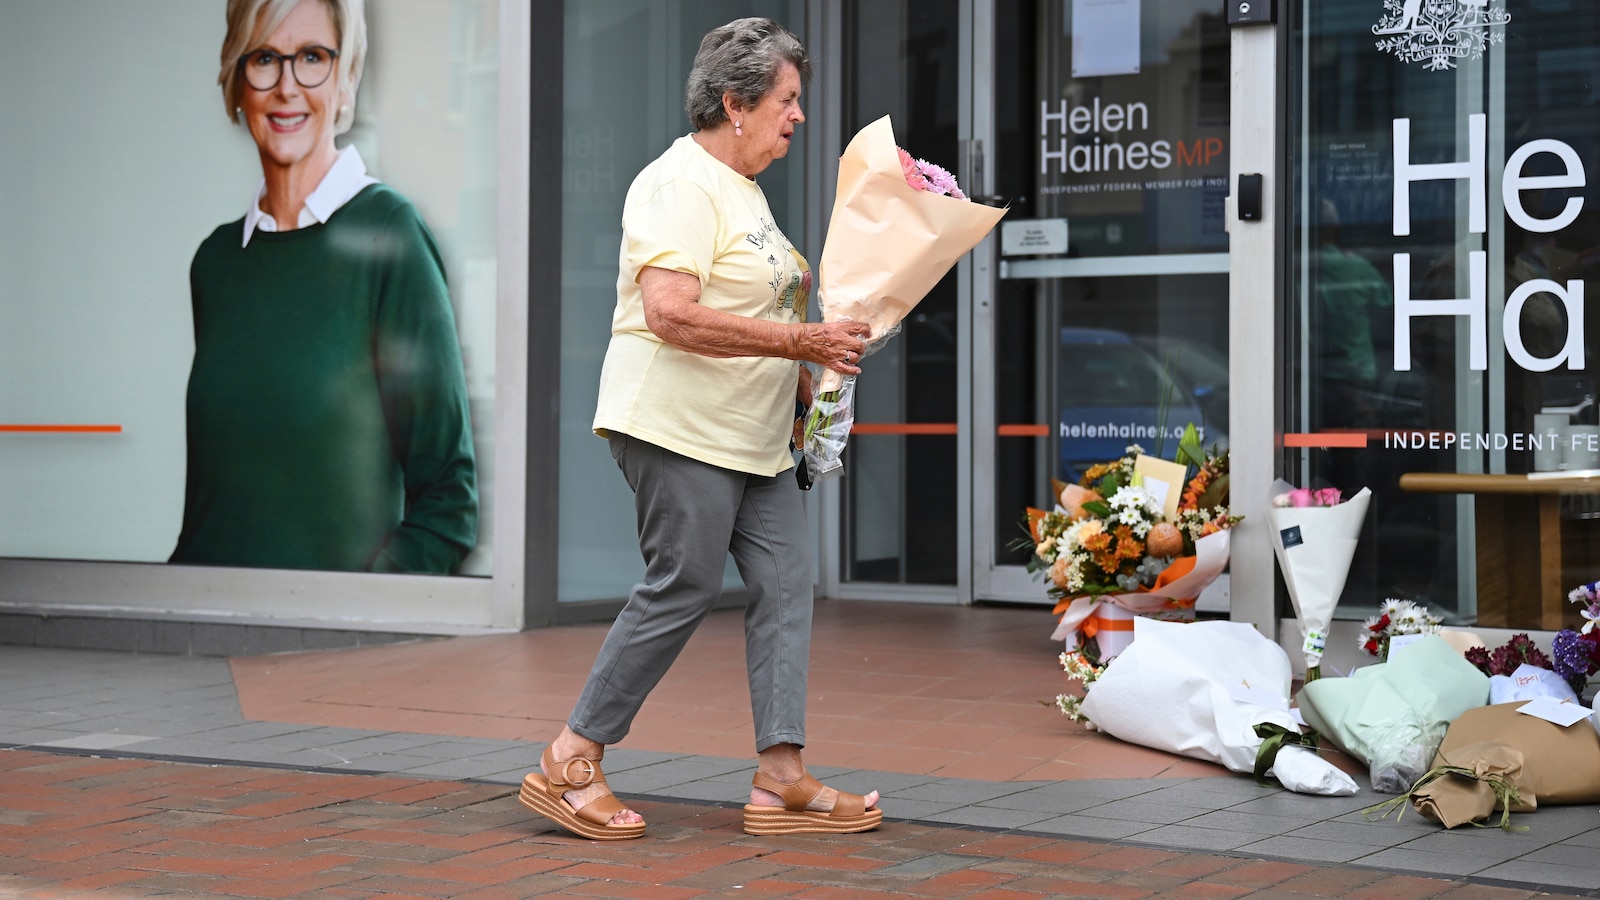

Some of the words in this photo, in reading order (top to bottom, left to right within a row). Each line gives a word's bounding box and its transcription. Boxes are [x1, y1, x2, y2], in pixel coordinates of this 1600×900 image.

[1415, 46, 1465, 59] AUSTRALIA
[1040, 96, 1149, 136] Helen
[1040, 136, 1172, 175] Haines
[1176, 137, 1224, 169] MP
[1392, 113, 1587, 236] He
[1040, 184, 1101, 195] INDEPENDENT
[1103, 182, 1143, 192] FEDERAL
[1145, 180, 1182, 190] MEMBER
[1185, 178, 1203, 188] FOR
[1392, 250, 1586, 373] Ha
[1384, 431, 1559, 452] INDEPENDENT
[1571, 433, 1600, 452] FE
